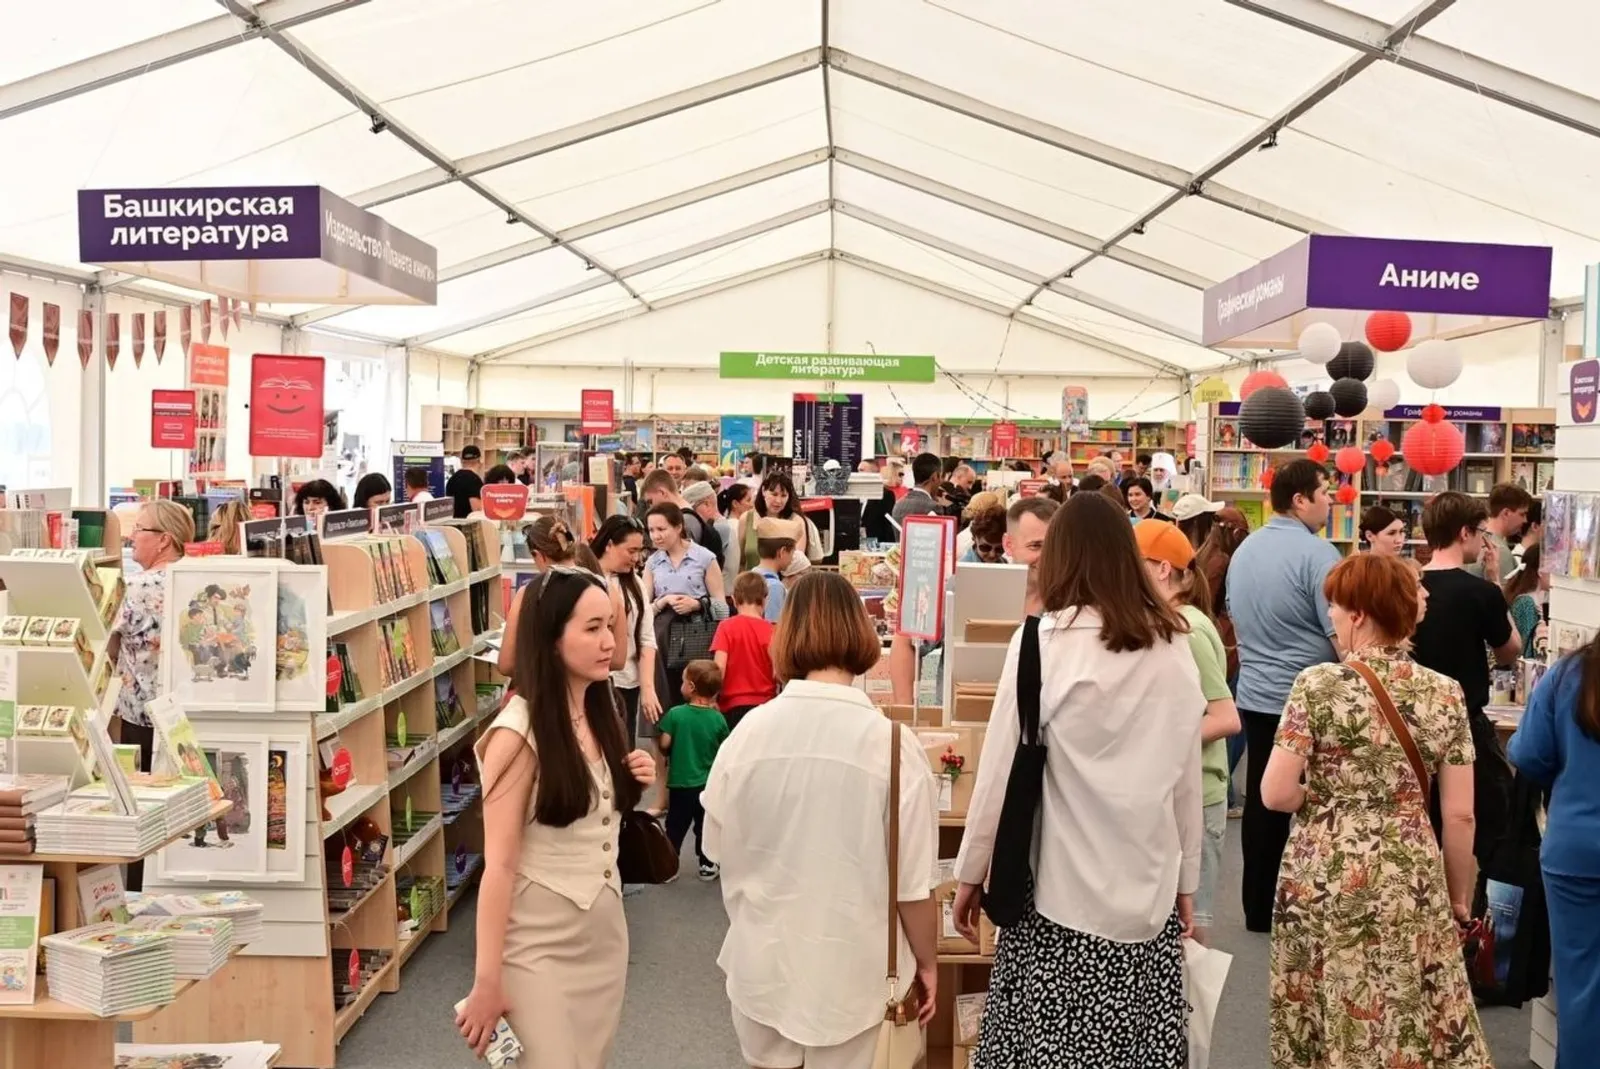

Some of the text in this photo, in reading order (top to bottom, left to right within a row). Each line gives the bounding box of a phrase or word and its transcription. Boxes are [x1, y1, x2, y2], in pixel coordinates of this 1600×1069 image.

[103, 194, 294, 223] Башкирская
[110, 223, 289, 251] литература
[325, 209, 383, 259] Издательство
[1379, 263, 1480, 291] Аниме
[1254, 273, 1285, 312] романы
[756, 353, 900, 369] Детская развивающая
[790, 365, 865, 377] литература
[1453, 409, 1483, 418] романы
